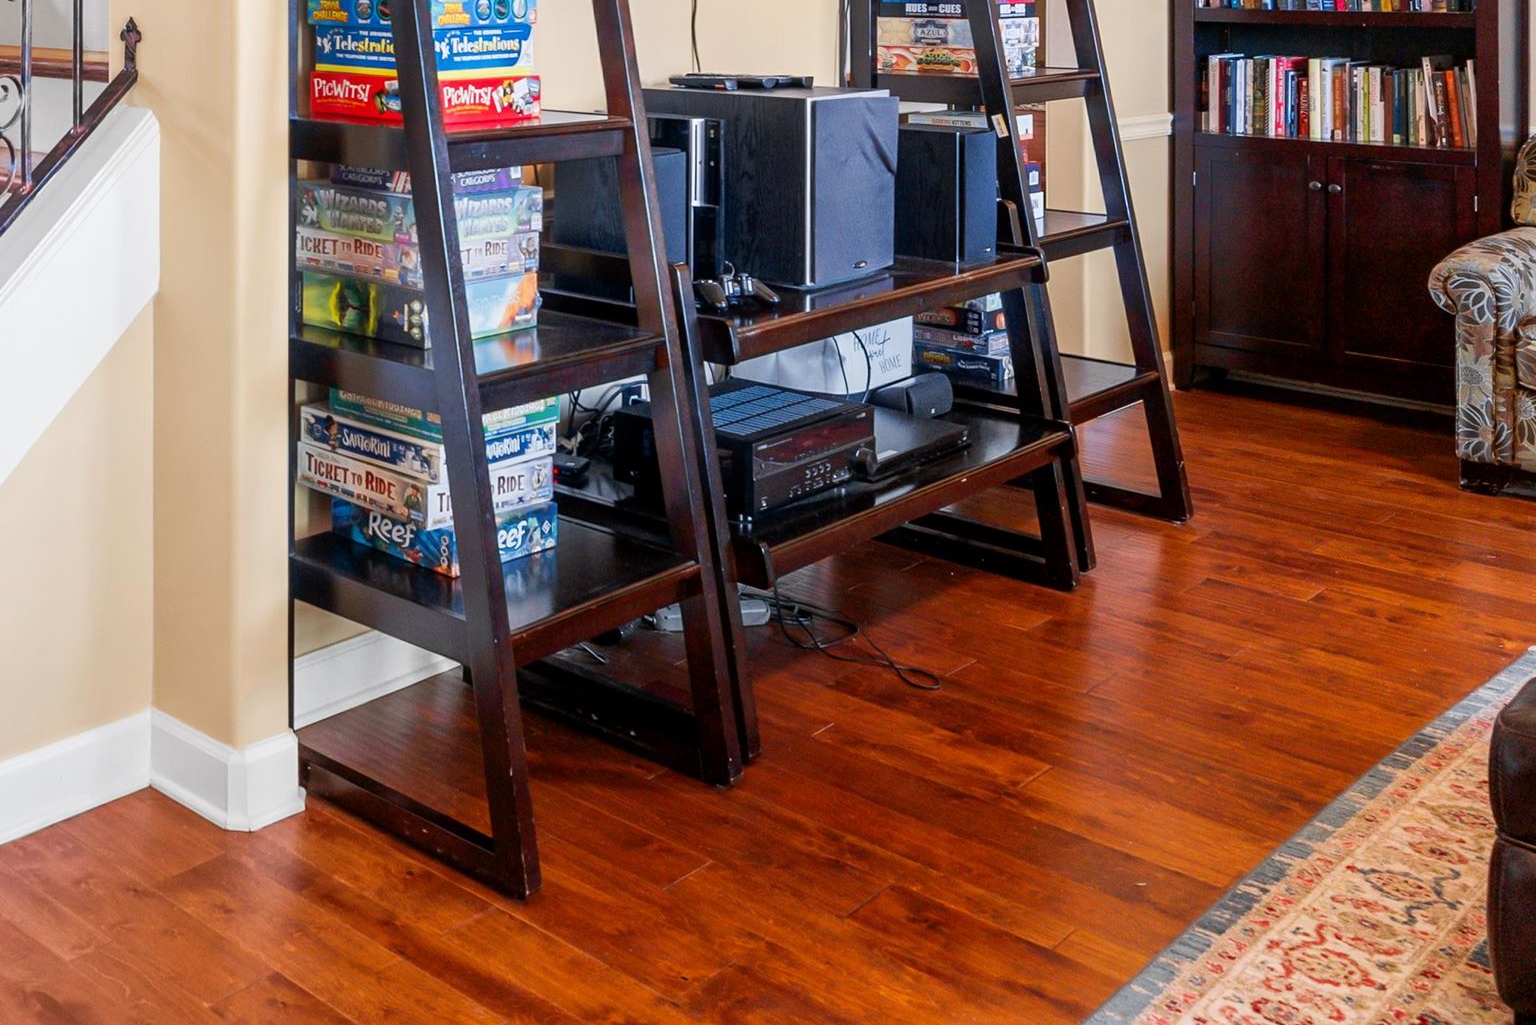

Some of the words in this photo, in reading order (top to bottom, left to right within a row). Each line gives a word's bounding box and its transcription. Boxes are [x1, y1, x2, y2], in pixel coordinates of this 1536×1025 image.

[313, 10, 349, 22] CHALLENGE
[905, 3, 928, 13] HUES
[938, 3, 962, 14] CUES
[450, 35, 519, 54] Telestrations
[1370, 71, 1378, 106] untangled
[319, 189, 388, 215] WIZARDS
[454, 197, 513, 219] WIZARDS
[327, 210, 385, 234] WANTED
[297, 231, 339, 255] ICKET
[341, 241, 352, 252] TO
[354, 238, 384, 259] RIDE
[485, 241, 507, 256] RIDE
[879, 354, 901, 374] HOME
[305, 451, 349, 485] TICKET
[351, 472, 363, 486] TO
[365, 470, 396, 501] RIDE
[497, 474, 524, 495] RIDE
[368, 511, 417, 548] Reef
[497, 520, 528, 550] eef
